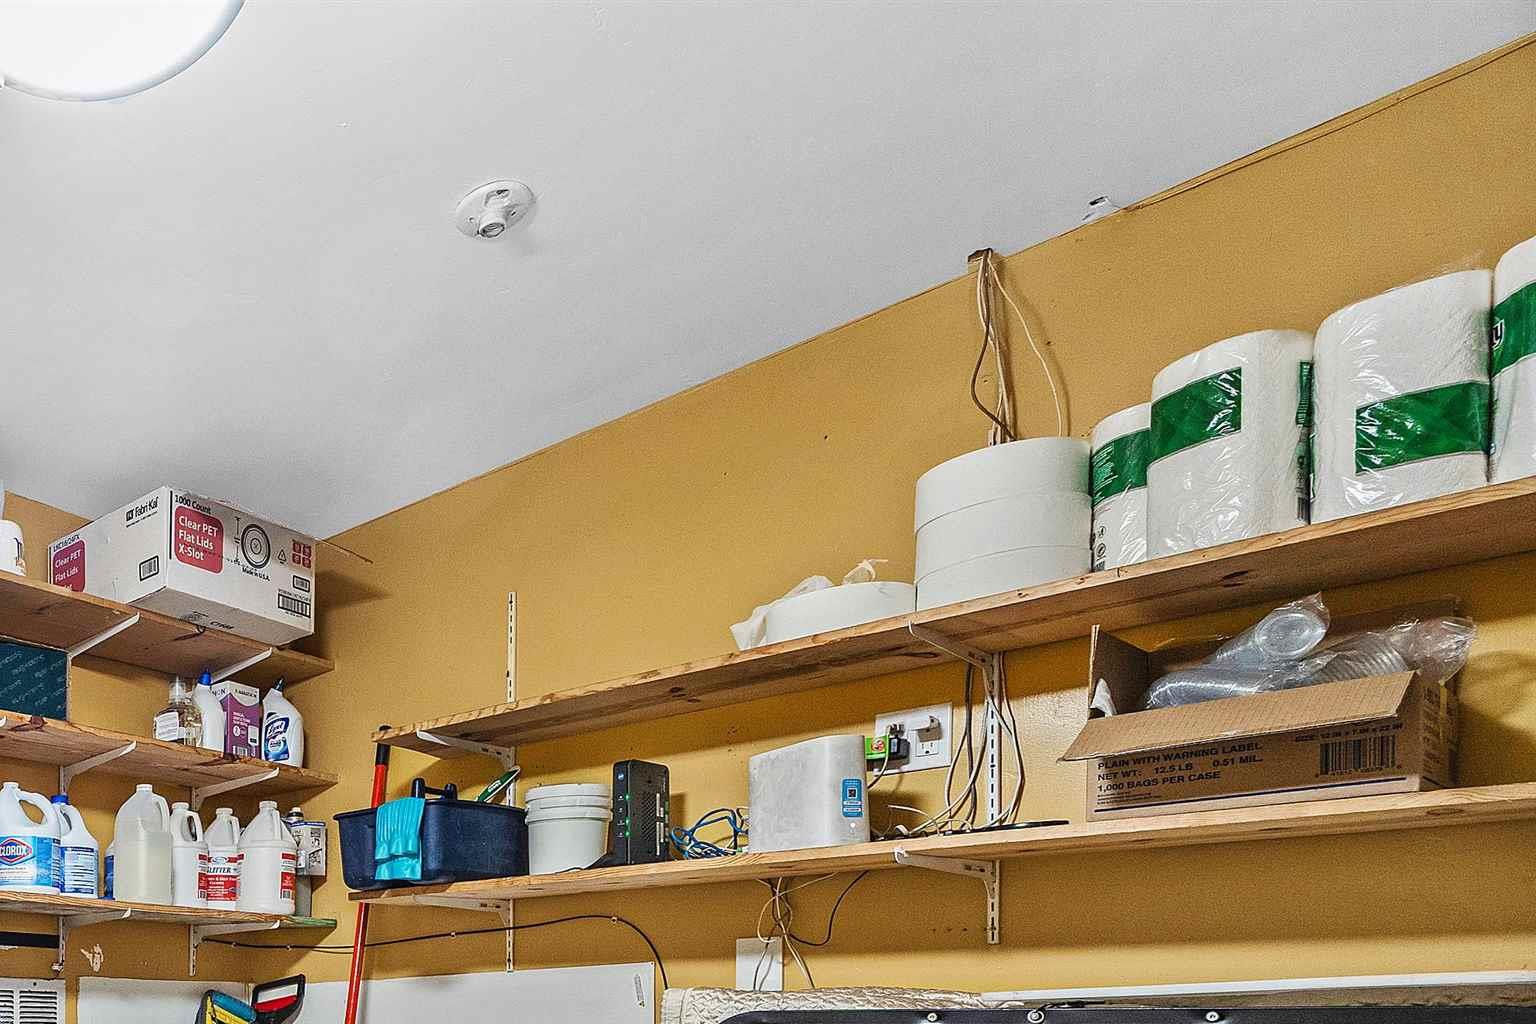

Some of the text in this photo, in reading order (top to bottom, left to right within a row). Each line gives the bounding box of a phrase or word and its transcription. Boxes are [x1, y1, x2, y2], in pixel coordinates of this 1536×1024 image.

[175, 495, 211, 514] 1000 Count
[178, 516, 218, 537] Clear PET
[178, 530, 214, 550] Flat Lids
[178, 543, 204, 560] X-Slot
[1098, 742, 1262, 770] PLAIN WITH WARNING LABEL
[1098, 770, 1119, 782] NET
[1122, 768, 1143, 779] WT:
[1155, 764, 1176, 775] 12.5
[1178, 762, 1193, 771] LB
[1213, 758, 1235, 768] 0.51
[1098, 771, 1221, 792] 1,000 BAGS PER CASE
[0, 845, 28, 857] CLOROX
